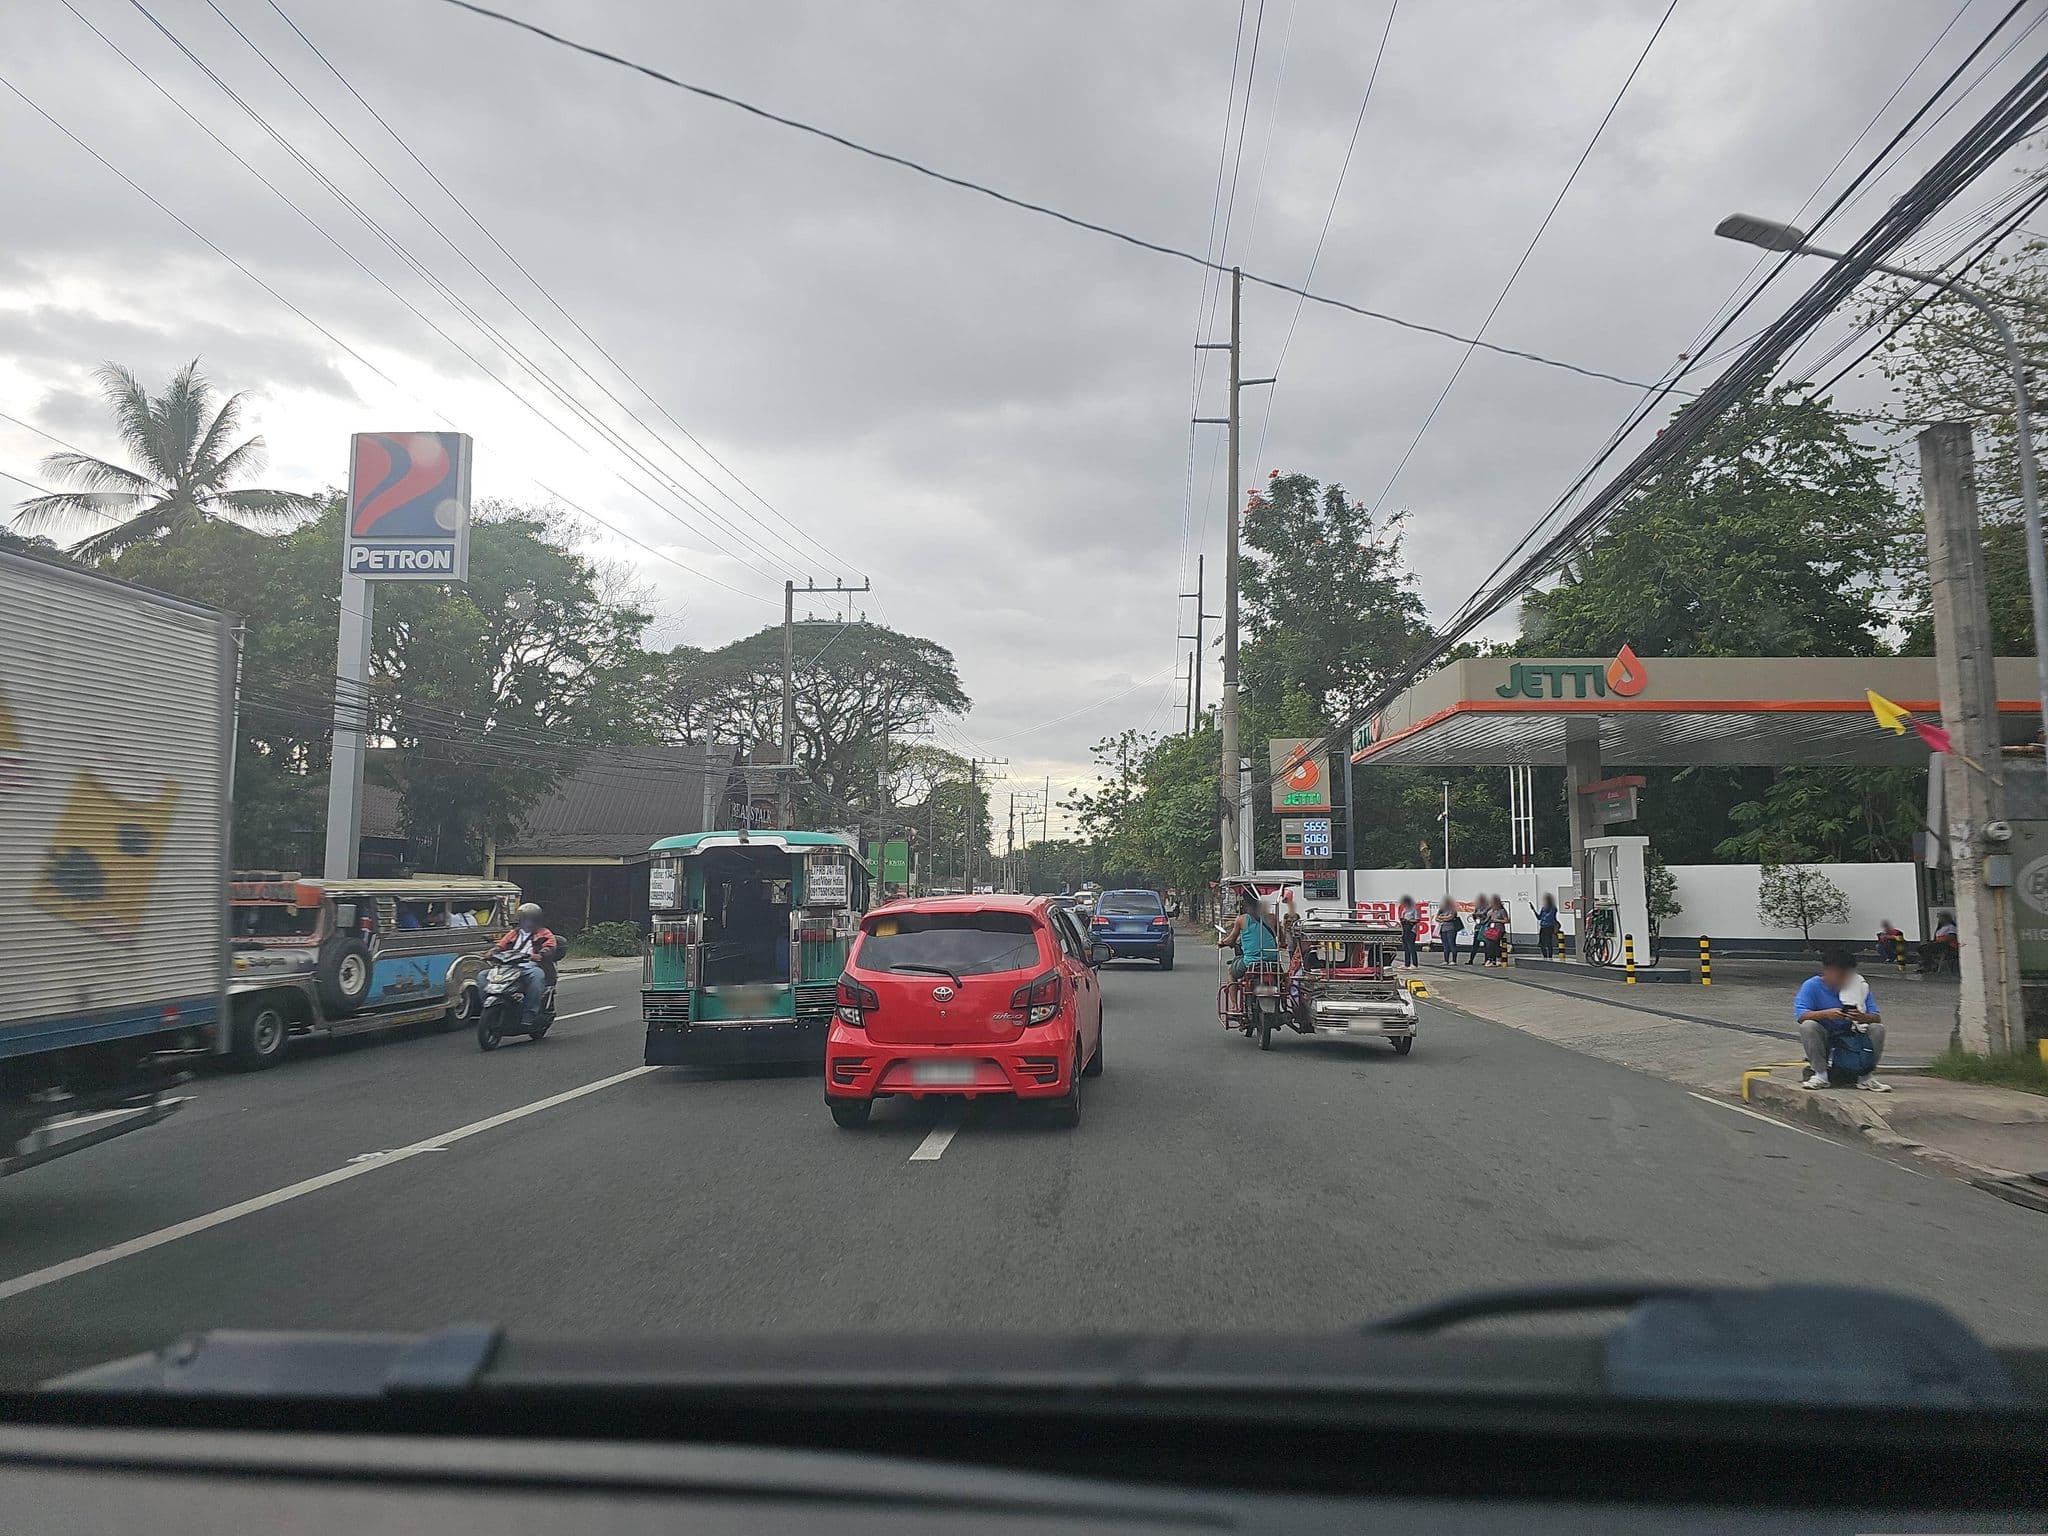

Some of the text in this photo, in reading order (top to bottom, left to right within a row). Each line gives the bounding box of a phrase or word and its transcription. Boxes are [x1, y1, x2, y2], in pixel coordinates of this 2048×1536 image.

[350, 546, 451, 569] PETRON
[1496, 662, 1605, 698] JETTI
[1283, 792, 1322, 805] JETTI
